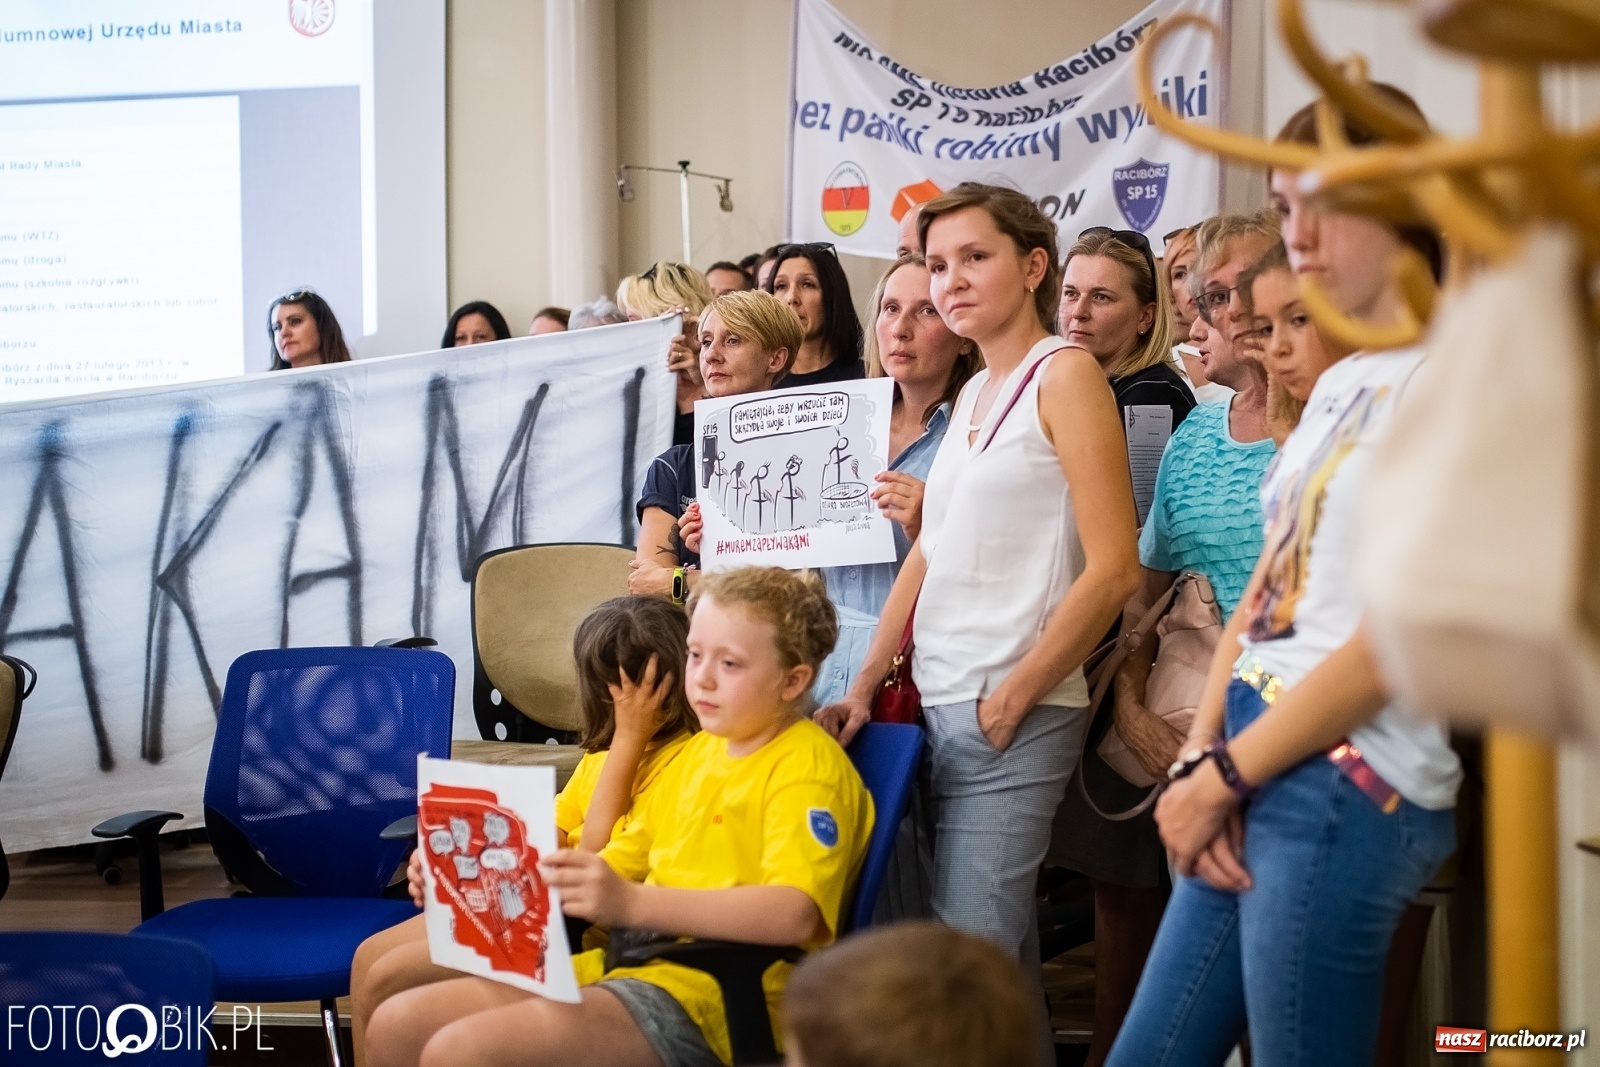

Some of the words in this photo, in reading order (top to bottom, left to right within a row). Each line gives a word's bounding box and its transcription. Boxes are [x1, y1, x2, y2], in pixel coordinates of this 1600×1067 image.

[101, 22, 171, 39] Urzędu
[180, 18, 242, 35] Miasta
[891, 88, 933, 111] SP
[793, 97, 831, 131] ez
[1114, 167, 1168, 181] RACIBÓRZ
[1126, 185, 1144, 200] SP
[1144, 184, 1158, 199] 15
[1037, 188, 1086, 220] ON
